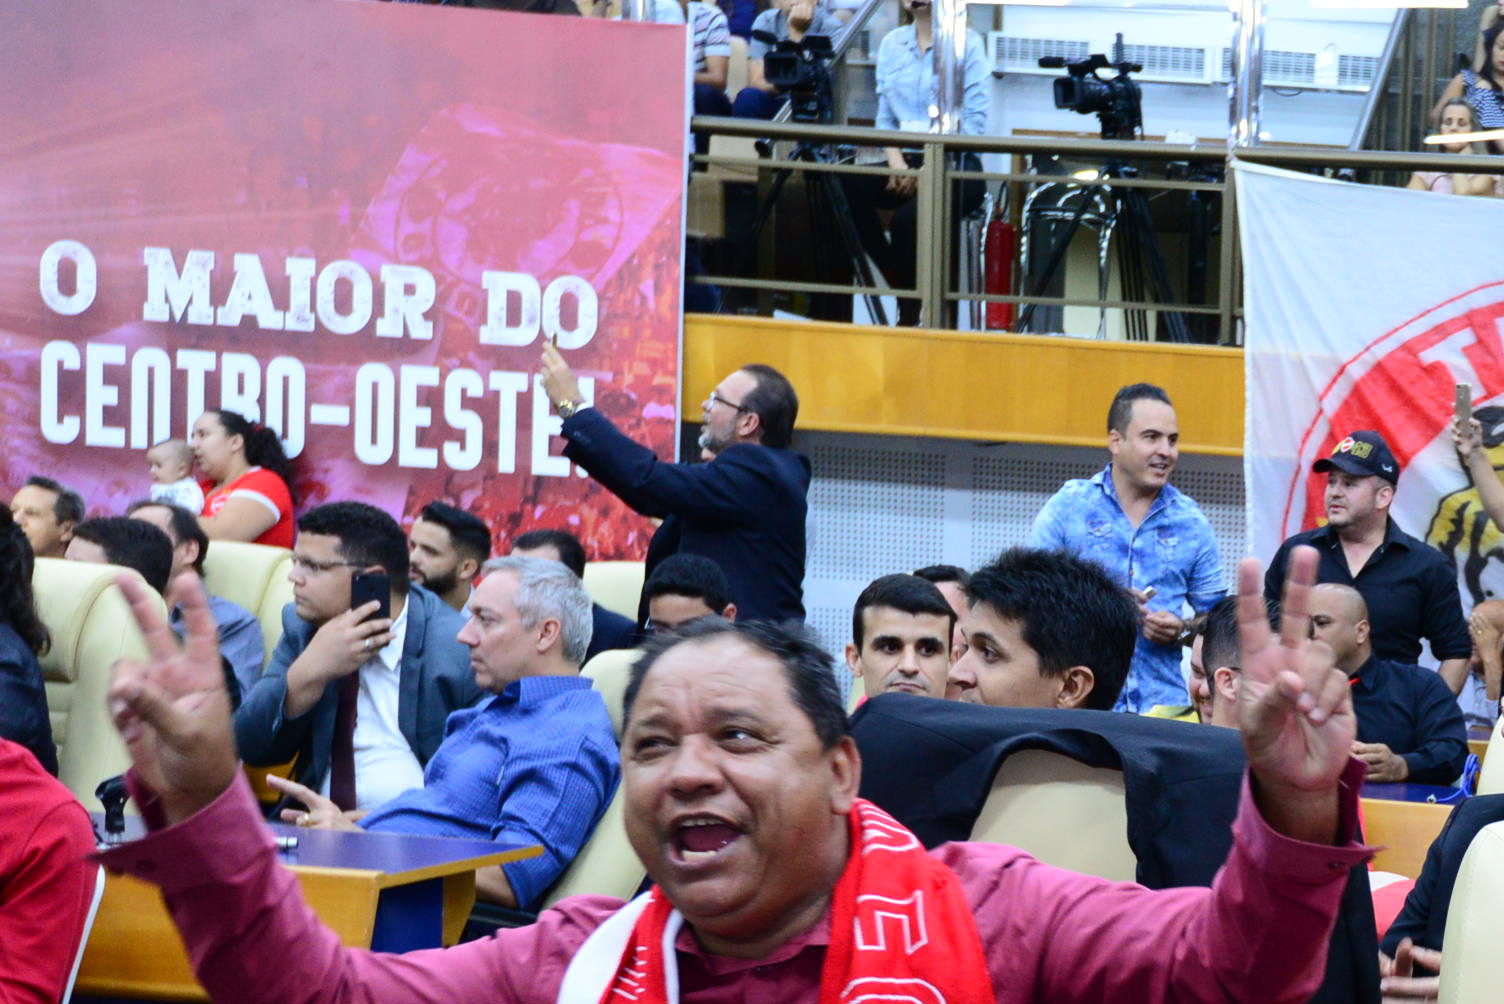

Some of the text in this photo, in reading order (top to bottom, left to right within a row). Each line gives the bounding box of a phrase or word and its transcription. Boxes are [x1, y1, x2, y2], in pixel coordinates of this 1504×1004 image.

[39, 239, 598, 350] O MAIOR DO
